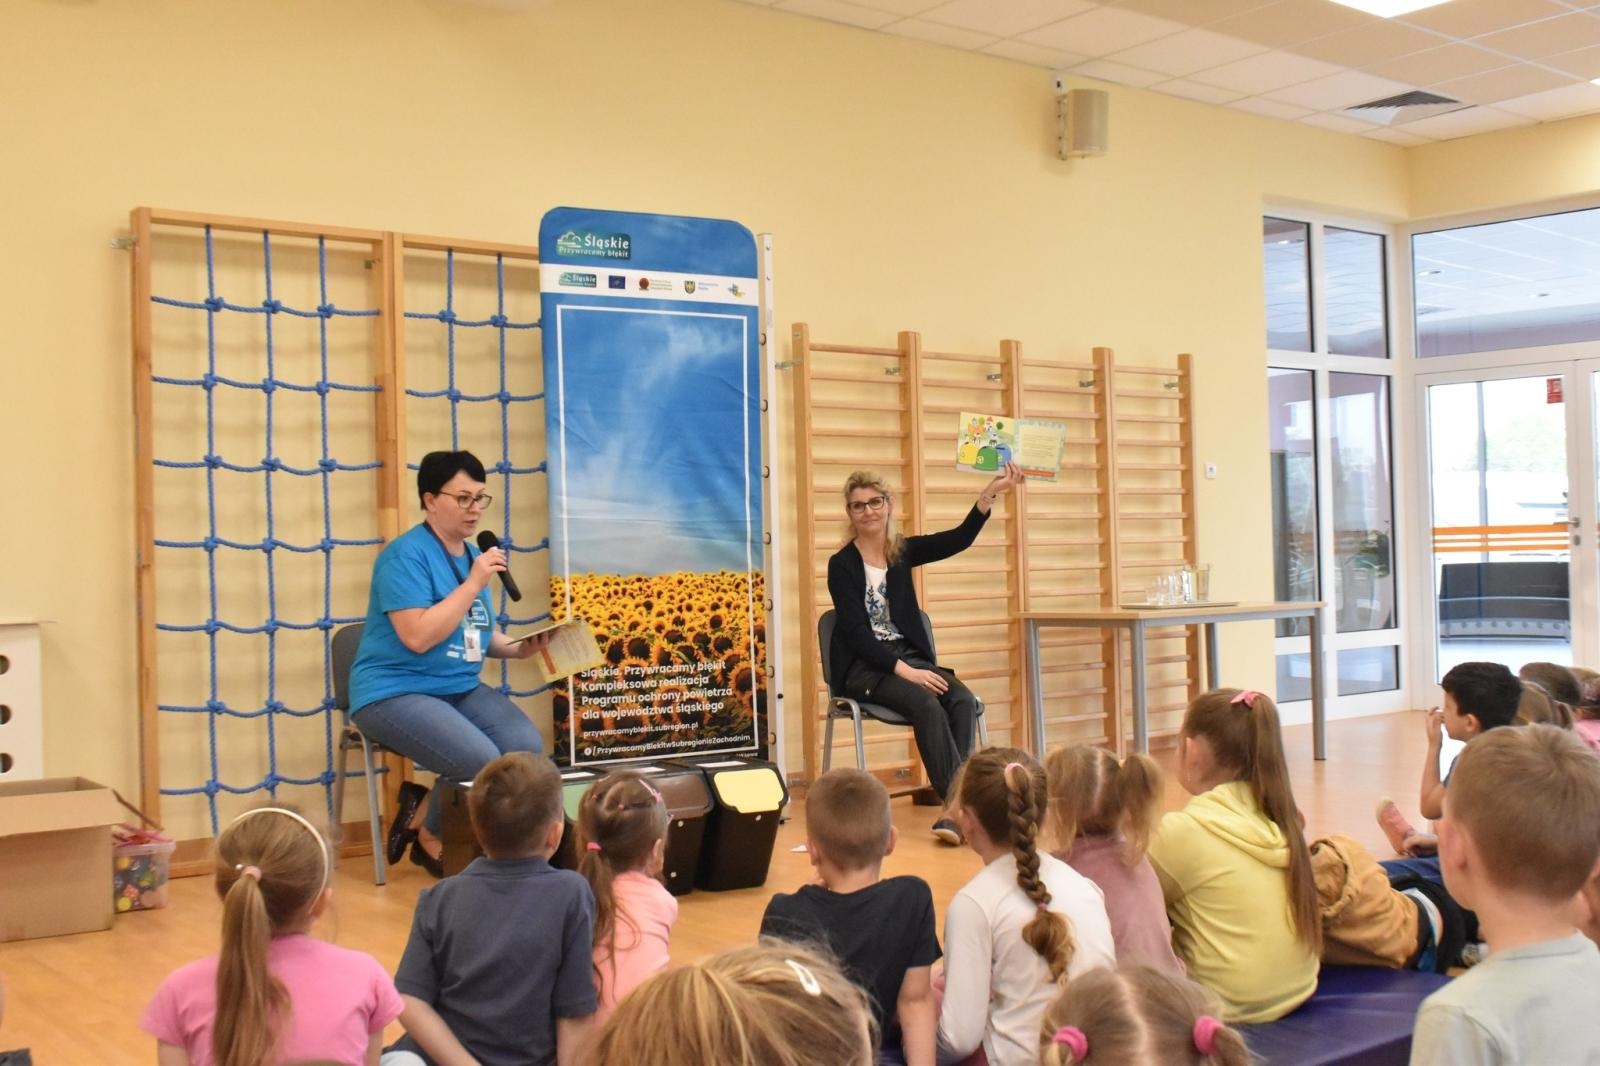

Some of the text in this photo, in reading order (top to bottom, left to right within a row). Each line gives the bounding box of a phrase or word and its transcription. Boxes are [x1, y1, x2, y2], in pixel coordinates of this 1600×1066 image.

[584, 233, 629, 249] Śląskie
[607, 249, 629, 258] błękit
[624, 664, 695, 676] Przywracamy
[697, 660, 726, 672] błękit
[581, 675, 709, 692] Kompleksowa realizacja
[581, 687, 733, 707] Programu ochrony powietrza
[582, 701, 724, 720] dla województwa śląskiego
[583, 722, 698, 738] przywracamyblekit.subregion.pl
